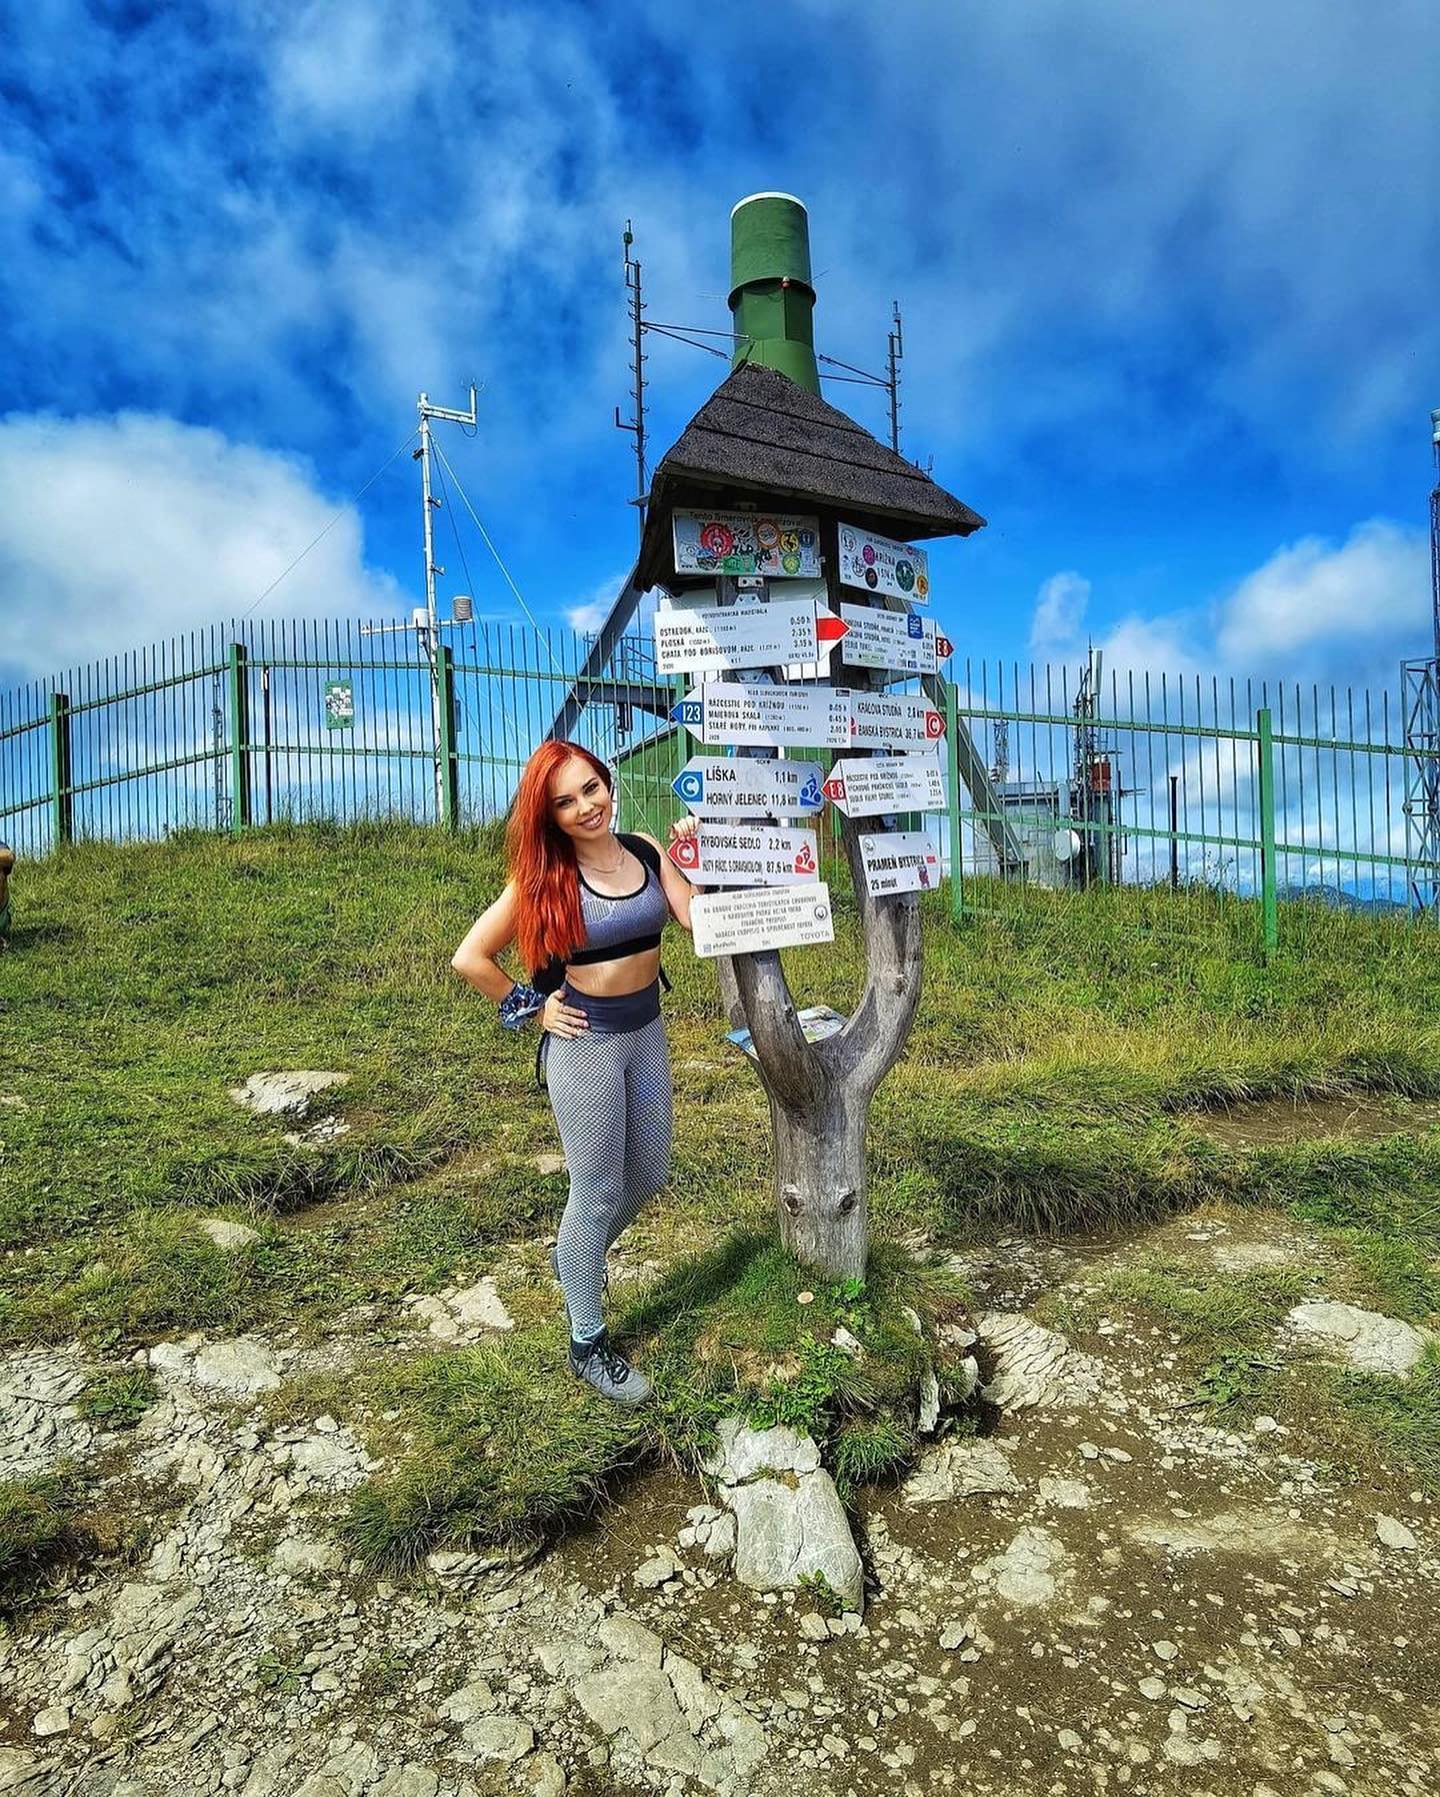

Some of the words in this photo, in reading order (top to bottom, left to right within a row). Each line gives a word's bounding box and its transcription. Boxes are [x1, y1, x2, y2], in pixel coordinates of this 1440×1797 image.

[661, 638, 685, 648] PLOSKÁ
[937, 640, 949, 656] E8
[661, 649, 681, 659] CHATA
[684, 648, 697, 657] POD
[744, 700, 755, 708] POD
[916, 708, 925, 719] km
[880, 726, 903, 739] BYSTRICA
[917, 729, 925, 740] km
[705, 765, 737, 782] LÍŠKA
[775, 771, 786, 783] 1,1
[787, 771, 798, 783] km
[829, 781, 844, 799] E8
[706, 790, 732, 806] HORNÝ
[735, 793, 768, 806] JELENEC
[772, 794, 787, 807] 11,8
[788, 794, 798, 806] km
[700, 833, 738, 849] RYBOVSKÉ
[738, 836, 761, 850] SEDLO
[768, 838, 780, 851] 2,2
[781, 839, 792, 850] km
[782, 861, 793, 873] km
[867, 854, 898, 872] PRAMEŇ
[871, 878, 880, 890] 25
[800, 930, 830, 940] TOYOTA
